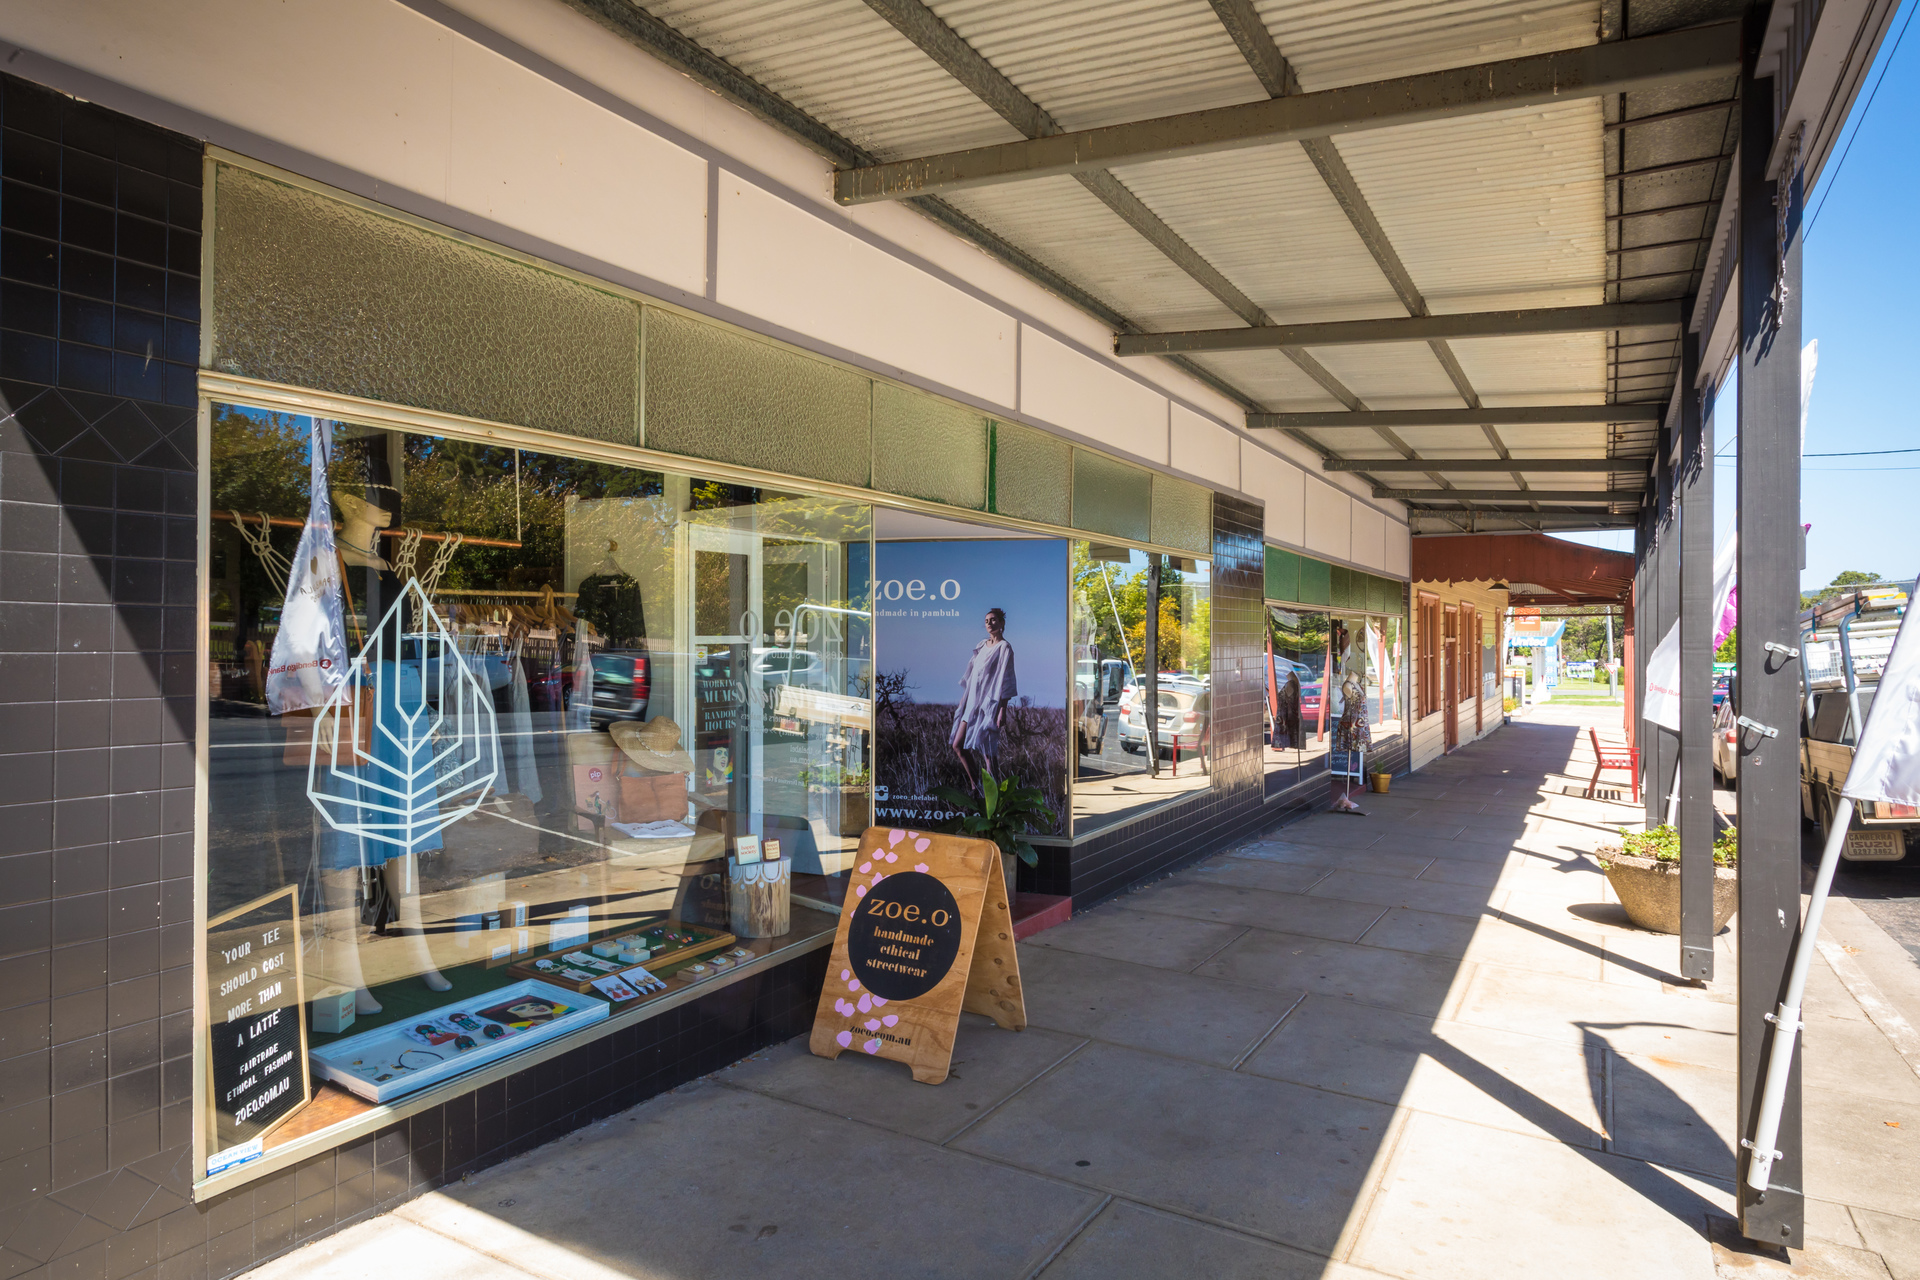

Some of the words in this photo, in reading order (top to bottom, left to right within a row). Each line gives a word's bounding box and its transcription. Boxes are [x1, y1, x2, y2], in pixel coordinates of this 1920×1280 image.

[864, 579, 961, 601] zoe.o
[875, 608, 908, 617] ndmade
[910, 608, 919, 617] in
[922, 608, 960, 619] pambula
[1511, 637, 1548, 647] United
[704, 690, 738, 703] MUMS
[704, 710, 736, 720] RANDOM
[705, 720, 736, 732] HOURS
[1848, 833, 1892, 841] CANBERRA
[867, 899, 949, 927] zoe.o
[262, 927, 280, 946] TEE
[873, 925, 934, 947] handmade
[880, 944, 921, 961] ethical
[220, 967, 258, 997] SHOULD
[262, 952, 285, 974] COST
[866, 958, 928, 978] streetwear
[227, 998, 253, 1024] MORE
[258, 981, 282, 1005] THAN
[237, 1033, 244, 1048] A
[849, 1025, 911, 1046] zoeo.com.au
[239, 1042, 279, 1076] FAIRTRADE
[226, 1074, 258, 1102] ETHICAL
[264, 1050, 293, 1076] FASHION
[235, 1076, 290, 1126] ZOEO.COM.AU
[211, 1151, 238, 1166] OCEAN
[239, 1144, 259, 1154] VIEW
